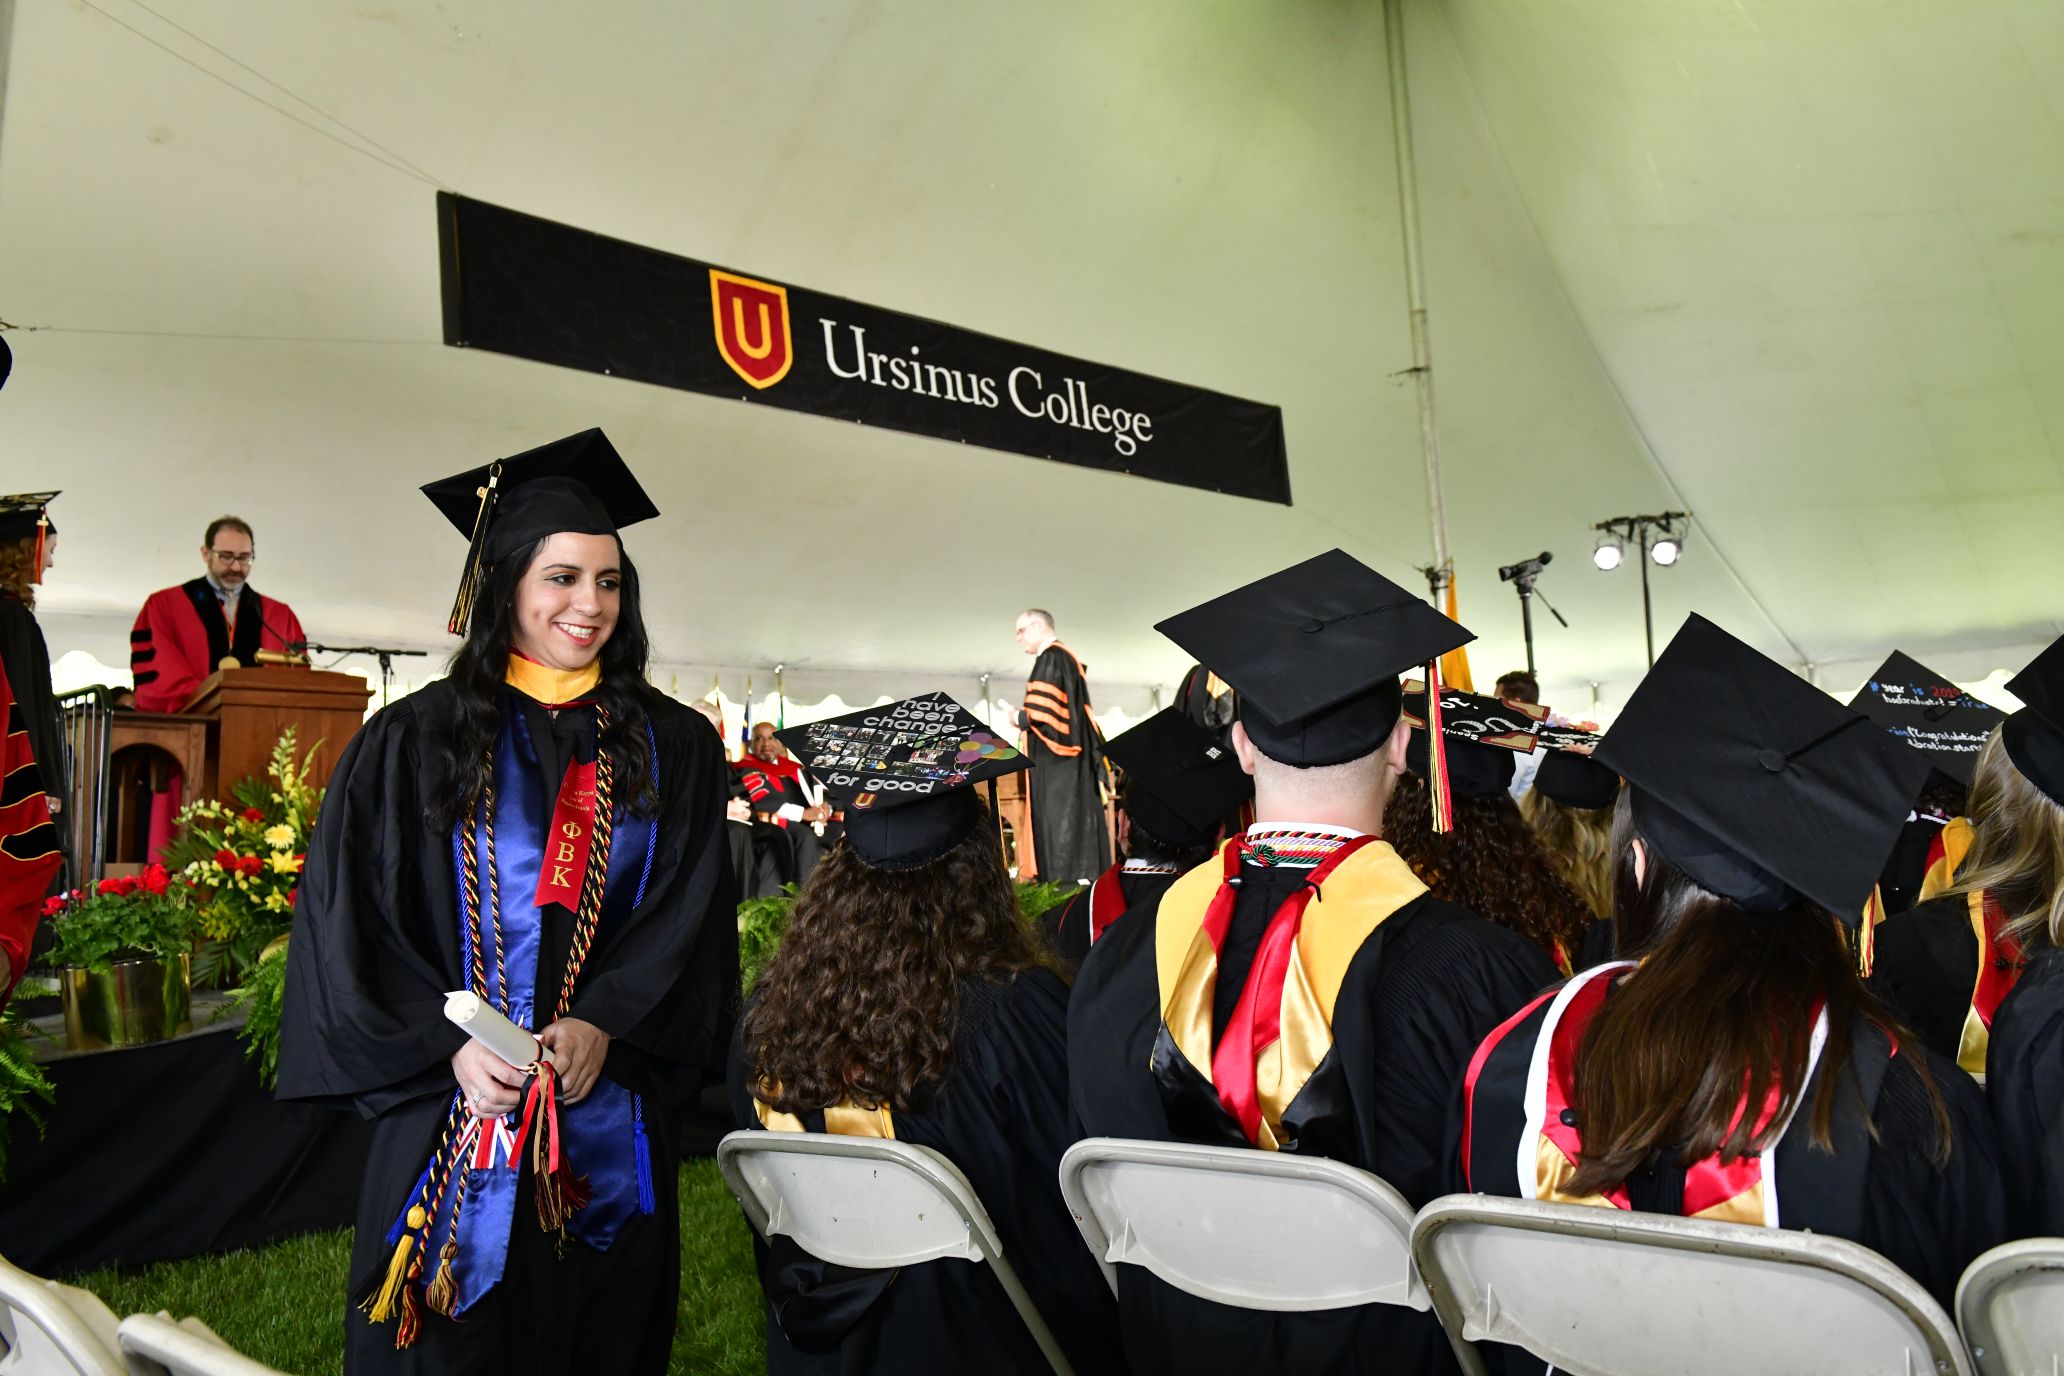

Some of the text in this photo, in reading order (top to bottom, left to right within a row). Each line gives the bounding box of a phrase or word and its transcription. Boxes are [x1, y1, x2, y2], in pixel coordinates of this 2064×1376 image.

[733, 297, 772, 360] U
[818, 318, 1153, 457] Ursinus College
[1881, 683, 1905, 694] year
[902, 698, 961, 713] have
[892, 706, 955, 722] been
[1441, 727, 1479, 741] Spanis
[826, 772, 935, 794] for good
